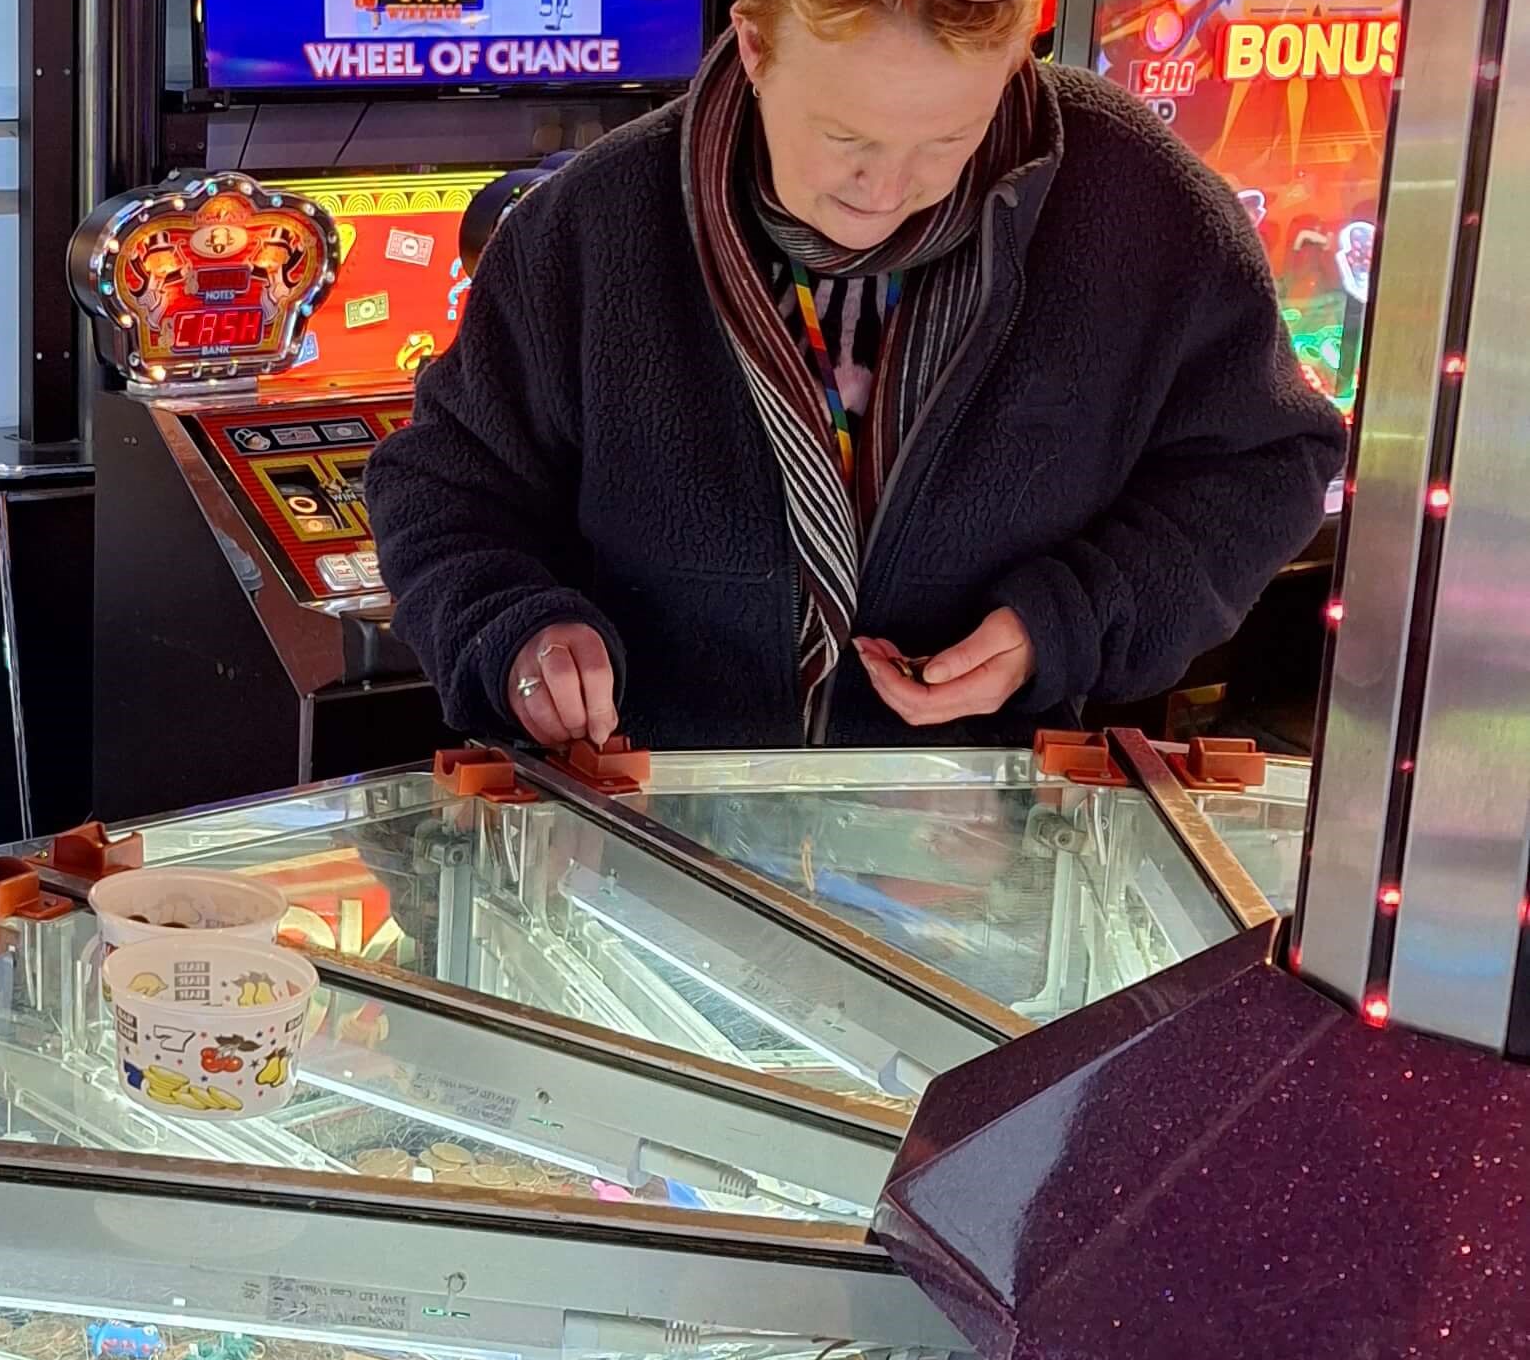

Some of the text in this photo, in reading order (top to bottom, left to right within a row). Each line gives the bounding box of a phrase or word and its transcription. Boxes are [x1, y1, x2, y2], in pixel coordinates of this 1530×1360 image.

[304, 40, 620, 79] WHEEL OF CHANCE
[1144, 60, 1195, 93] 500
[176, 312, 261, 347] CASH
[201, 346, 230, 355] BANK
